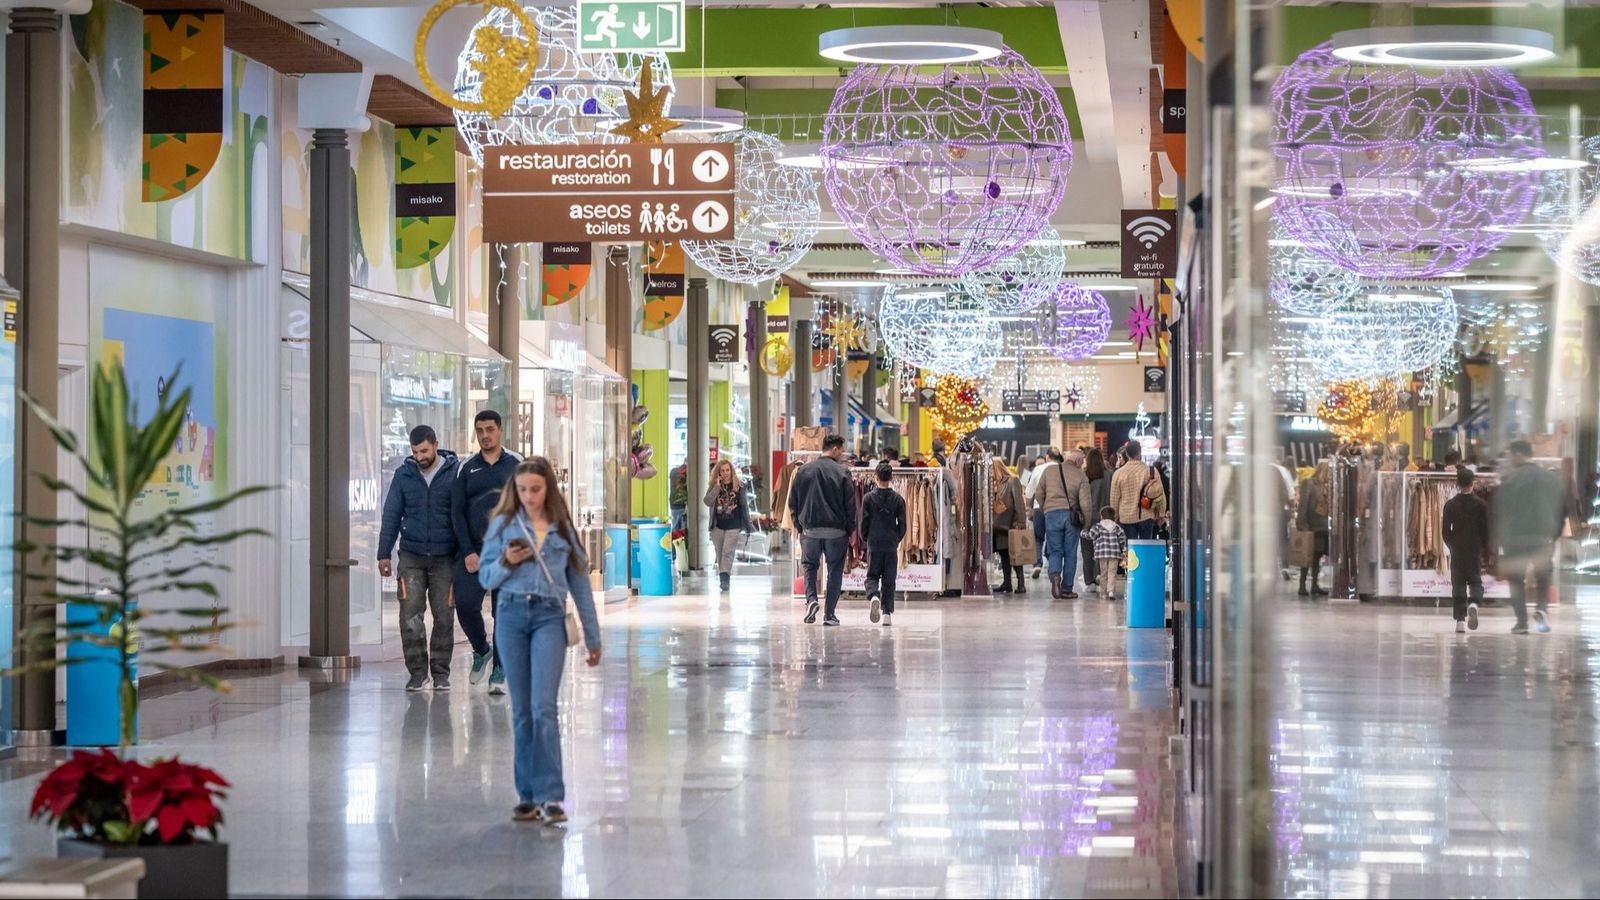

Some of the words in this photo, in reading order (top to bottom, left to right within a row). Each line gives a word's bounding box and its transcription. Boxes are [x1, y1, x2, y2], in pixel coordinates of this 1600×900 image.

[499, 149, 632, 170] restauración
[552, 171, 631, 185] restoration
[410, 195, 443, 204] misako
[569, 203, 632, 219] aseos
[585, 221, 631, 235] toilets
[552, 245, 580, 253] misako
[1140, 252, 1158, 261] wi-fi
[1133, 262, 1165, 272] gratuito
[349, 479, 377, 511] ISAKO
